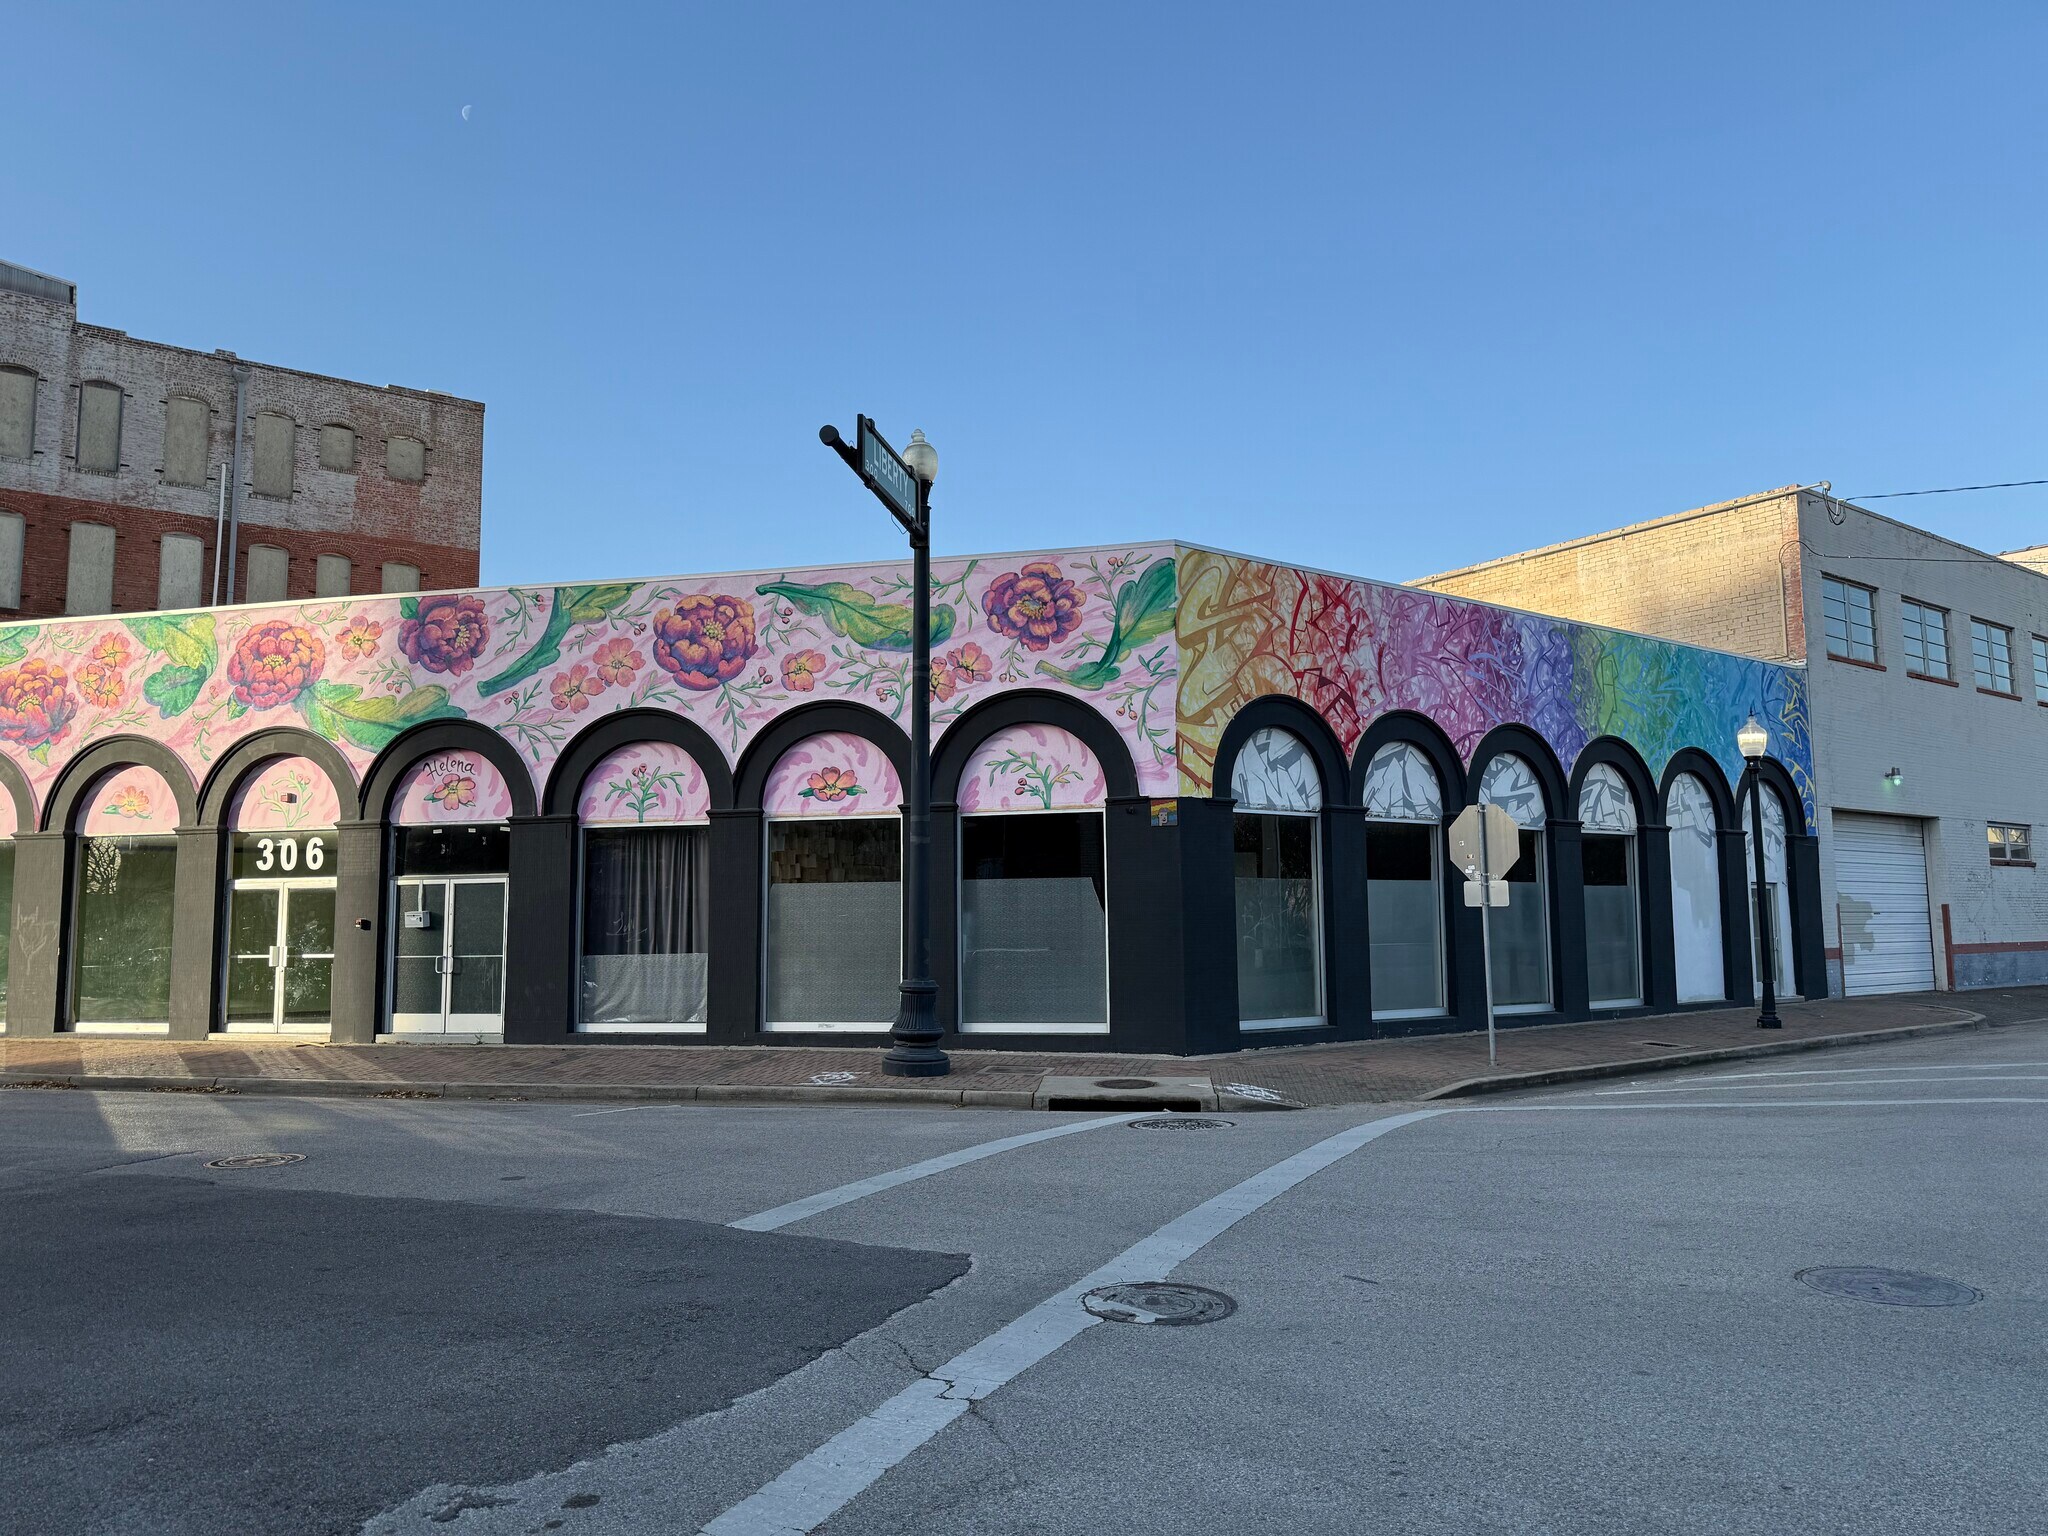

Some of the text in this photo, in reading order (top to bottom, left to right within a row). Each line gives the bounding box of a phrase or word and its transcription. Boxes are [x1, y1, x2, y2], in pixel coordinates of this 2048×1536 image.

[865, 459, 879, 480] 300
[873, 438, 909, 498] LIBERTY
[422, 755, 476, 782] Helena
[256, 837, 325, 871] 306
